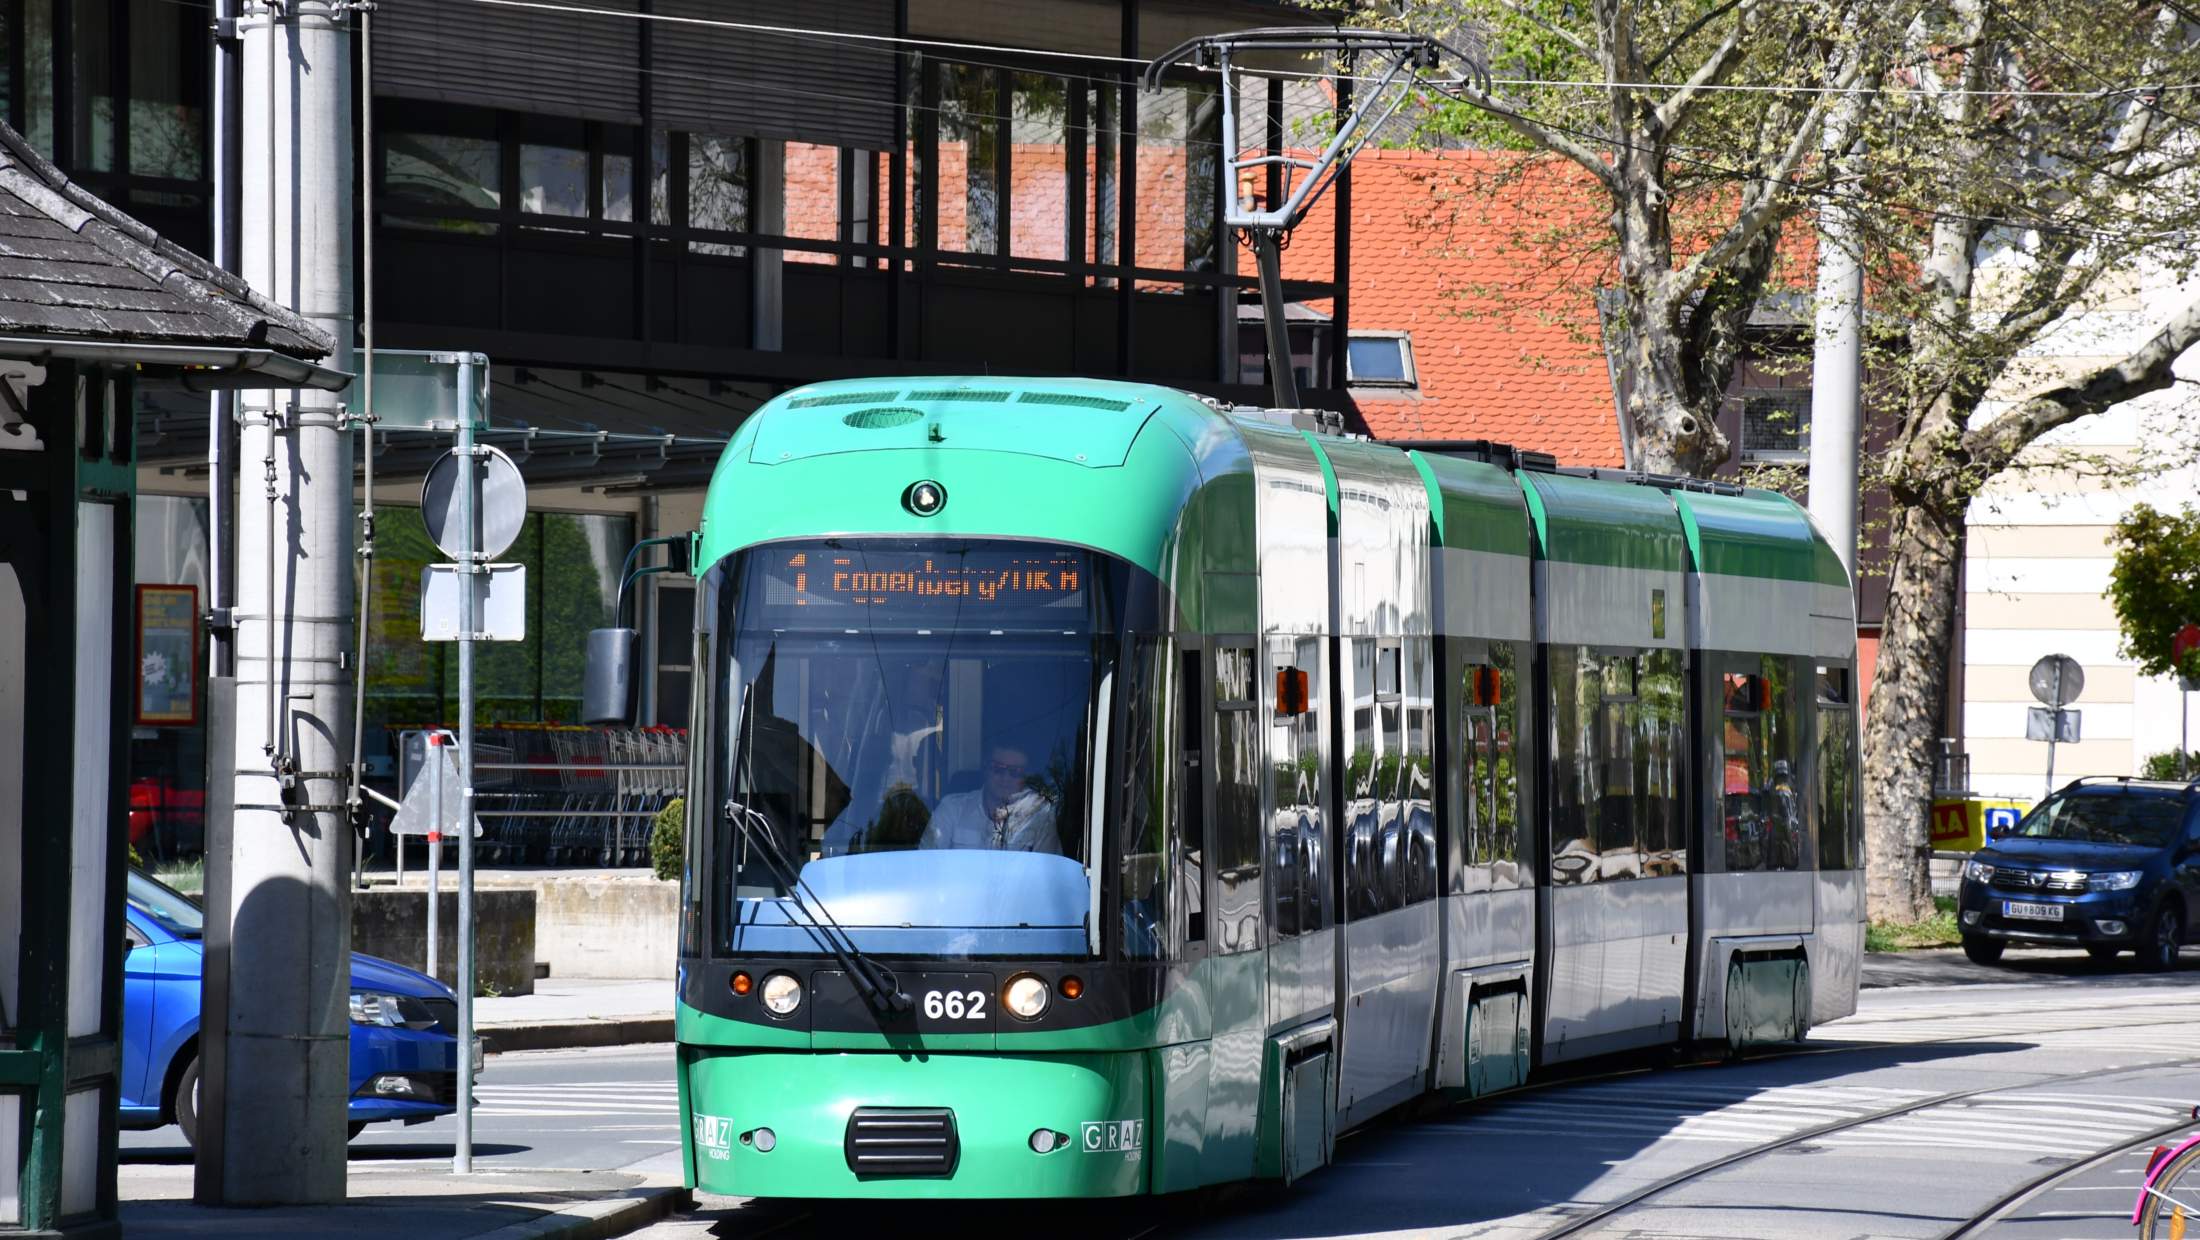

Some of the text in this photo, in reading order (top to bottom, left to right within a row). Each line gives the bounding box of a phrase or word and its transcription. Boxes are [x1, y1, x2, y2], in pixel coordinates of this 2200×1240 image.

[789, 554, 806, 605] 1
[2011, 903, 2060, 917] GU 809 KG
[923, 990, 986, 1019] 662
[694, 1115, 730, 1147] GRAZ
[1085, 1122, 1142, 1149] GRAZ
[709, 1148, 730, 1161] HOLDING
[1124, 1150, 1142, 1161] HOLDING
